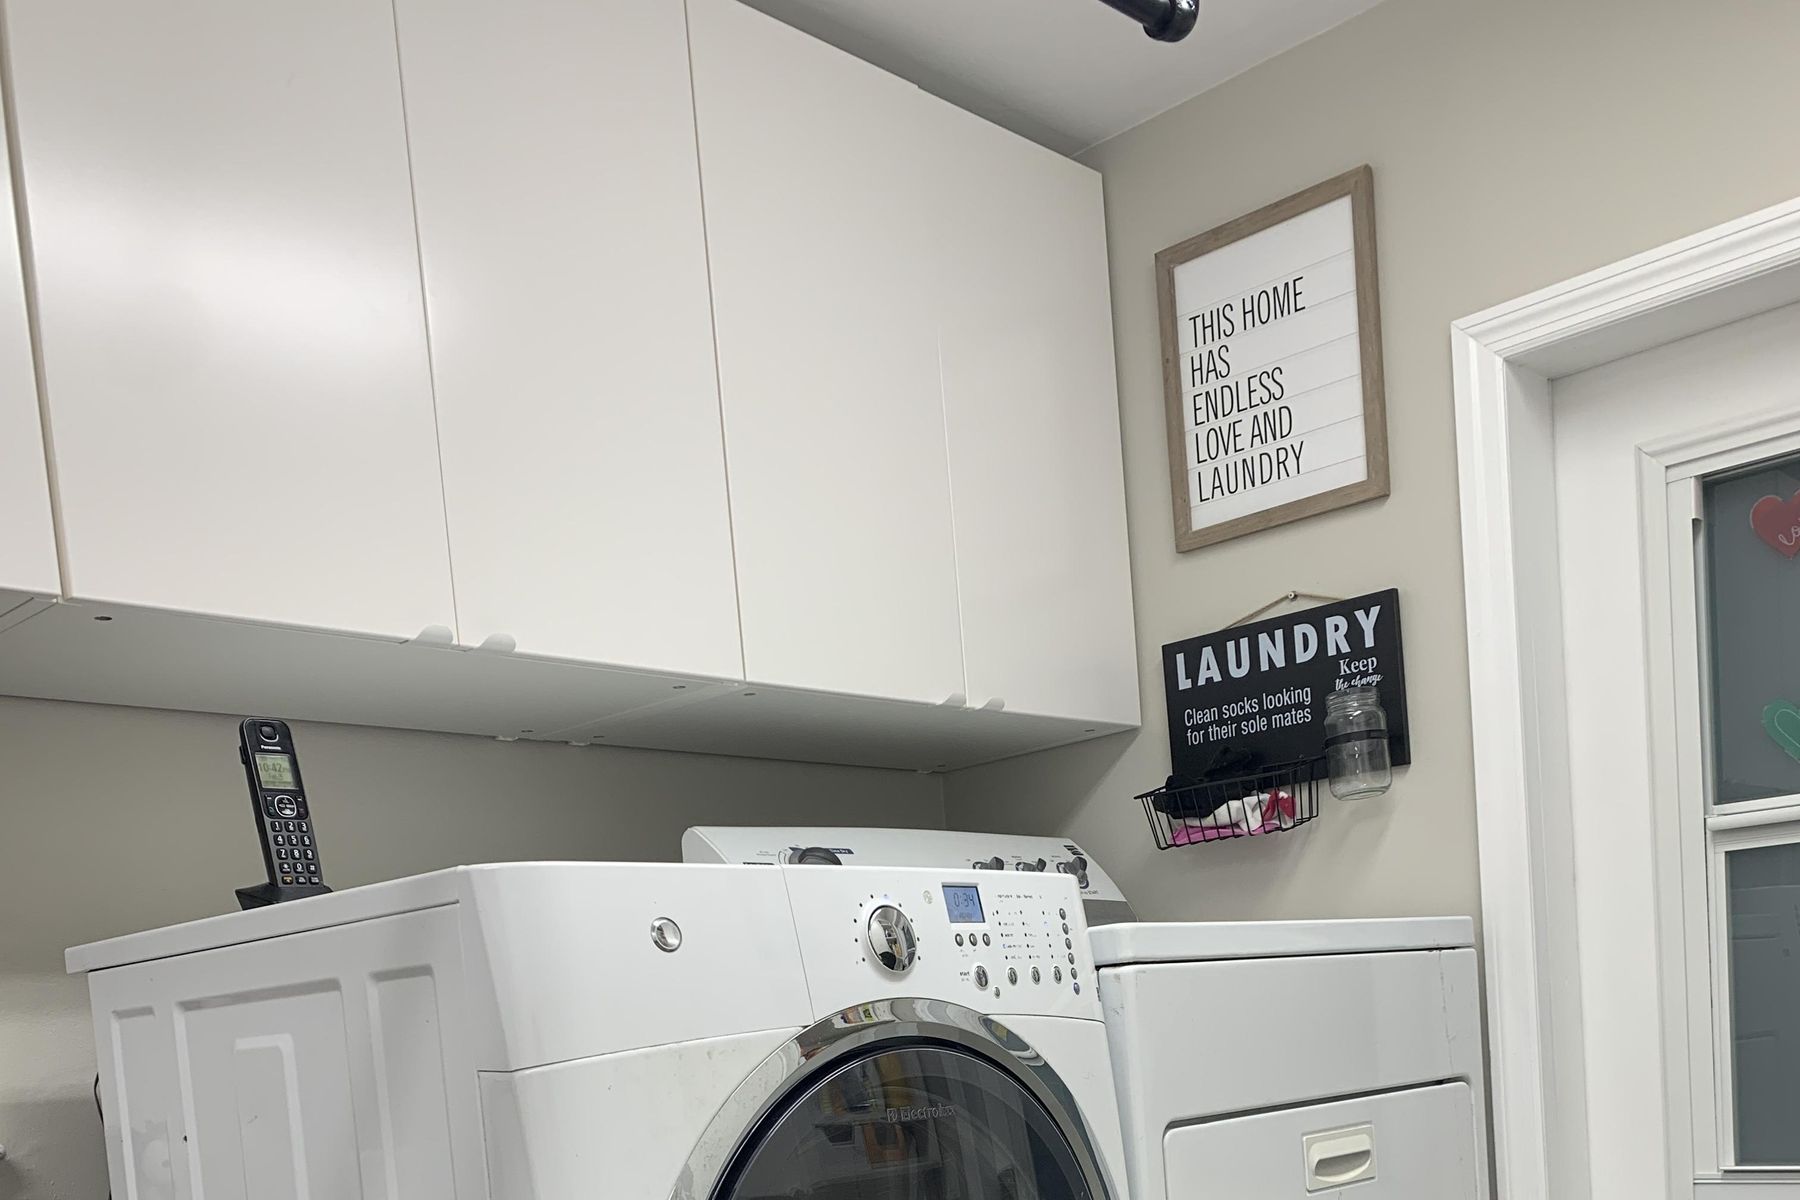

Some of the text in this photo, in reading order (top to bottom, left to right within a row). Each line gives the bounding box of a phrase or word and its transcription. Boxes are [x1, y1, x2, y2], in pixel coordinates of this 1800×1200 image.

[1189, 277, 1306, 348] THIS HOME
[1190, 344, 1231, 388] HAS
[1193, 367, 1284, 426] ENDLESS
[1195, 405, 1293, 464] LOVE AND
[1198, 441, 1305, 502] LAUNDRY
[1175, 605, 1382, 691] LAUNDRY
[1339, 657, 1377, 675] Keep
[1184, 686, 1312, 726] Clean socks looking
[1335, 674, 1384, 690] the change
[1187, 707, 1312, 746] for their sole mates
